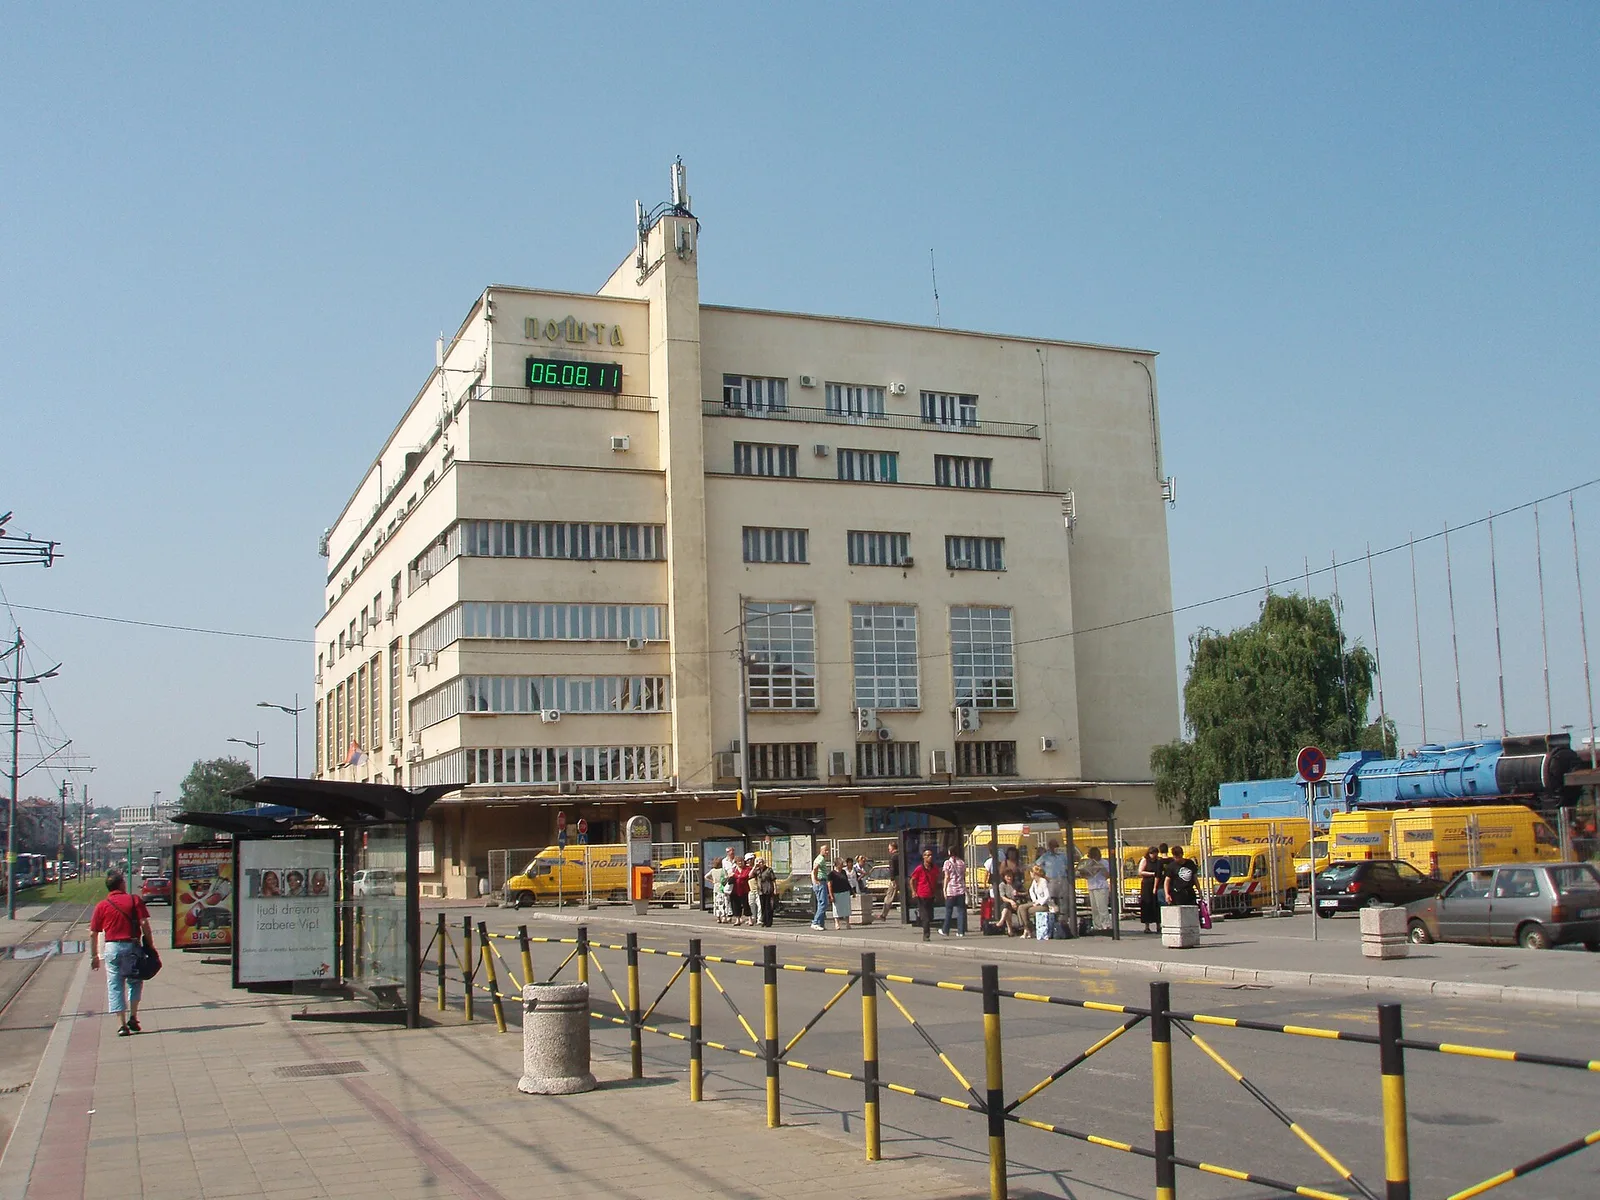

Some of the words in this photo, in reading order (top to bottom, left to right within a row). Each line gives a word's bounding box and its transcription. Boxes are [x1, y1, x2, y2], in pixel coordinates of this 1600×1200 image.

[524, 316, 625, 346] ПОШТА
[530, 363, 619, 387] 06.08.11
[256, 904, 278, 918] ljudi
[256, 919, 296, 930] izabere
[298, 918, 319, 932] Vip!
[192, 932, 225, 940] BINGO
[311, 967, 325, 977] vip
